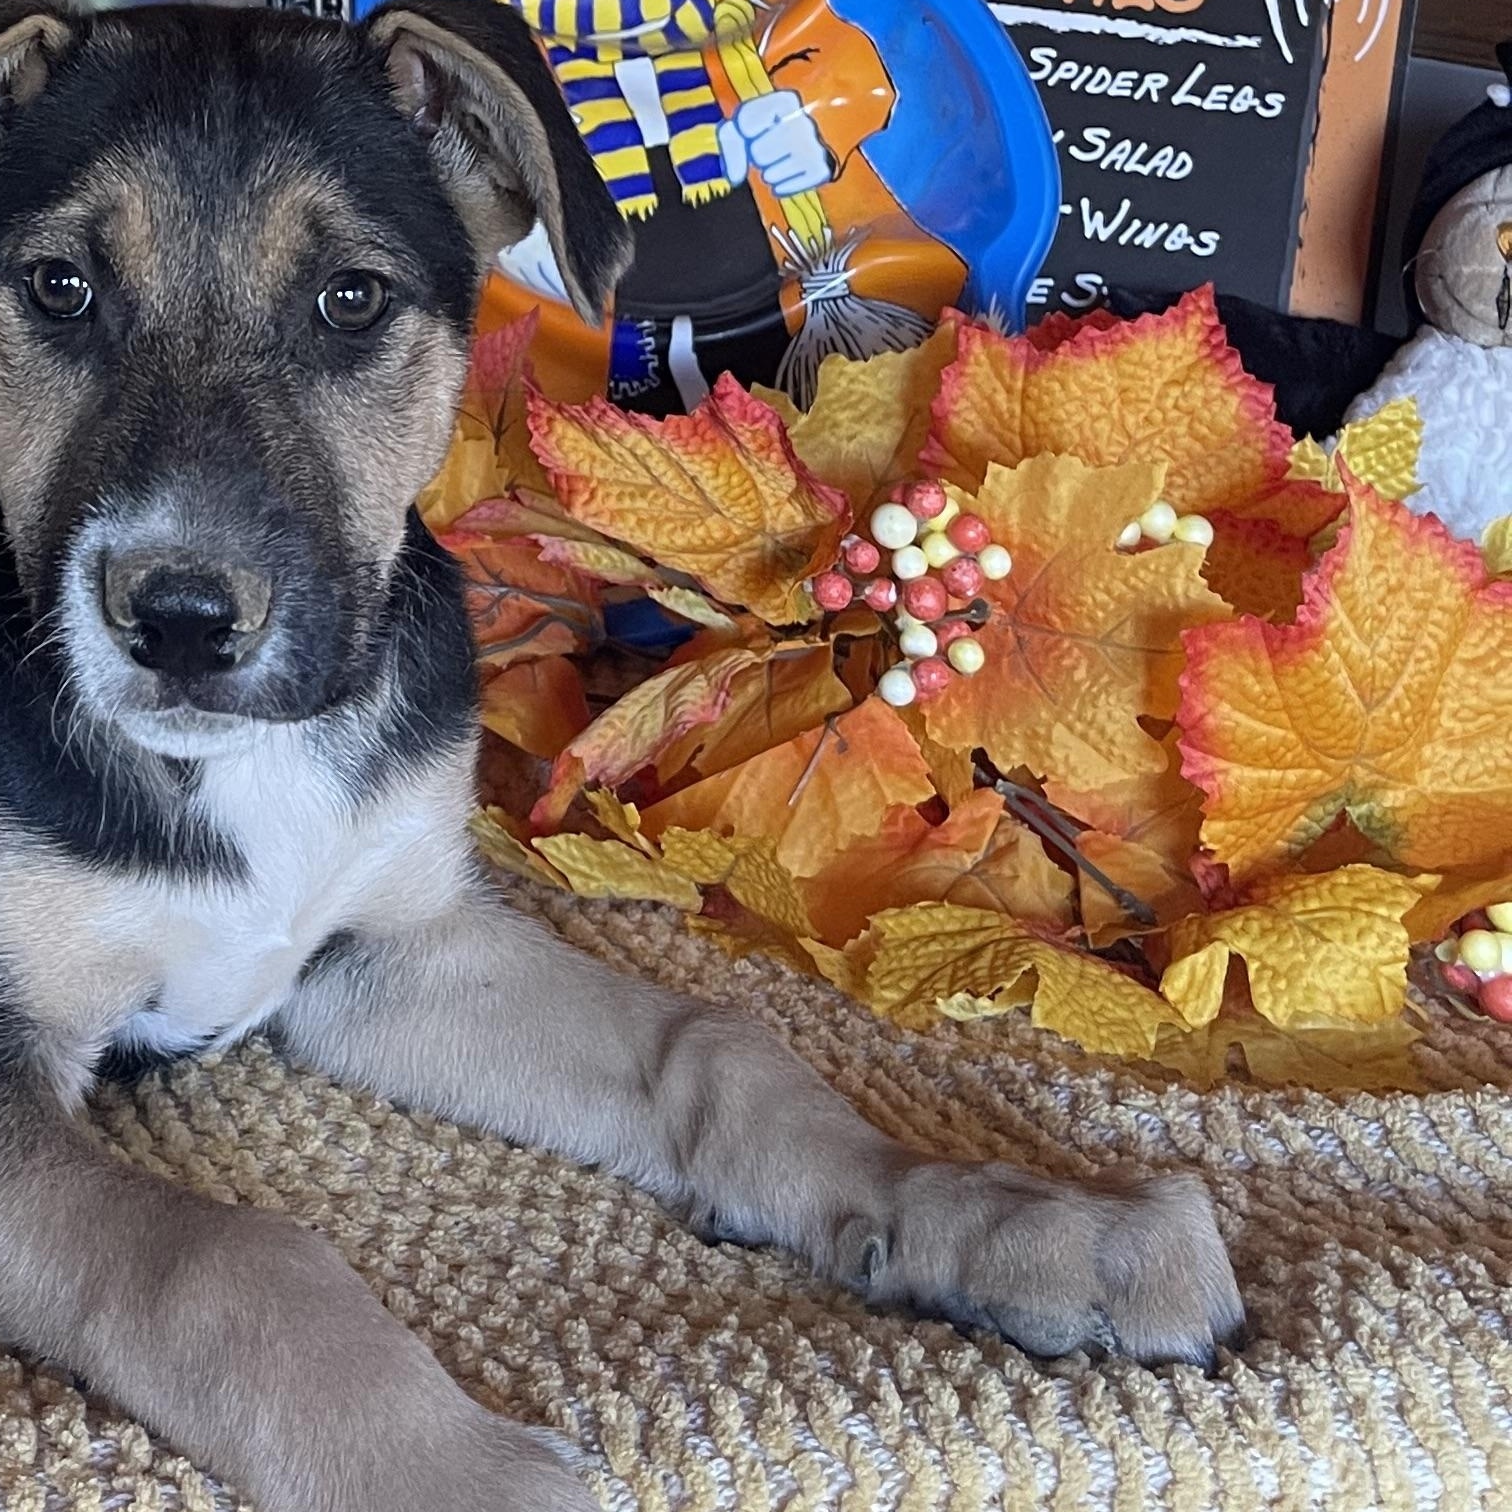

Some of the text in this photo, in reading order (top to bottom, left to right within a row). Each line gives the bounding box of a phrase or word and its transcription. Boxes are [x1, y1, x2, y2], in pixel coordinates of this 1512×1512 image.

[1027, 46, 1287, 119] SPIDER LEGS
[1068, 127, 1194, 180] SALAD
